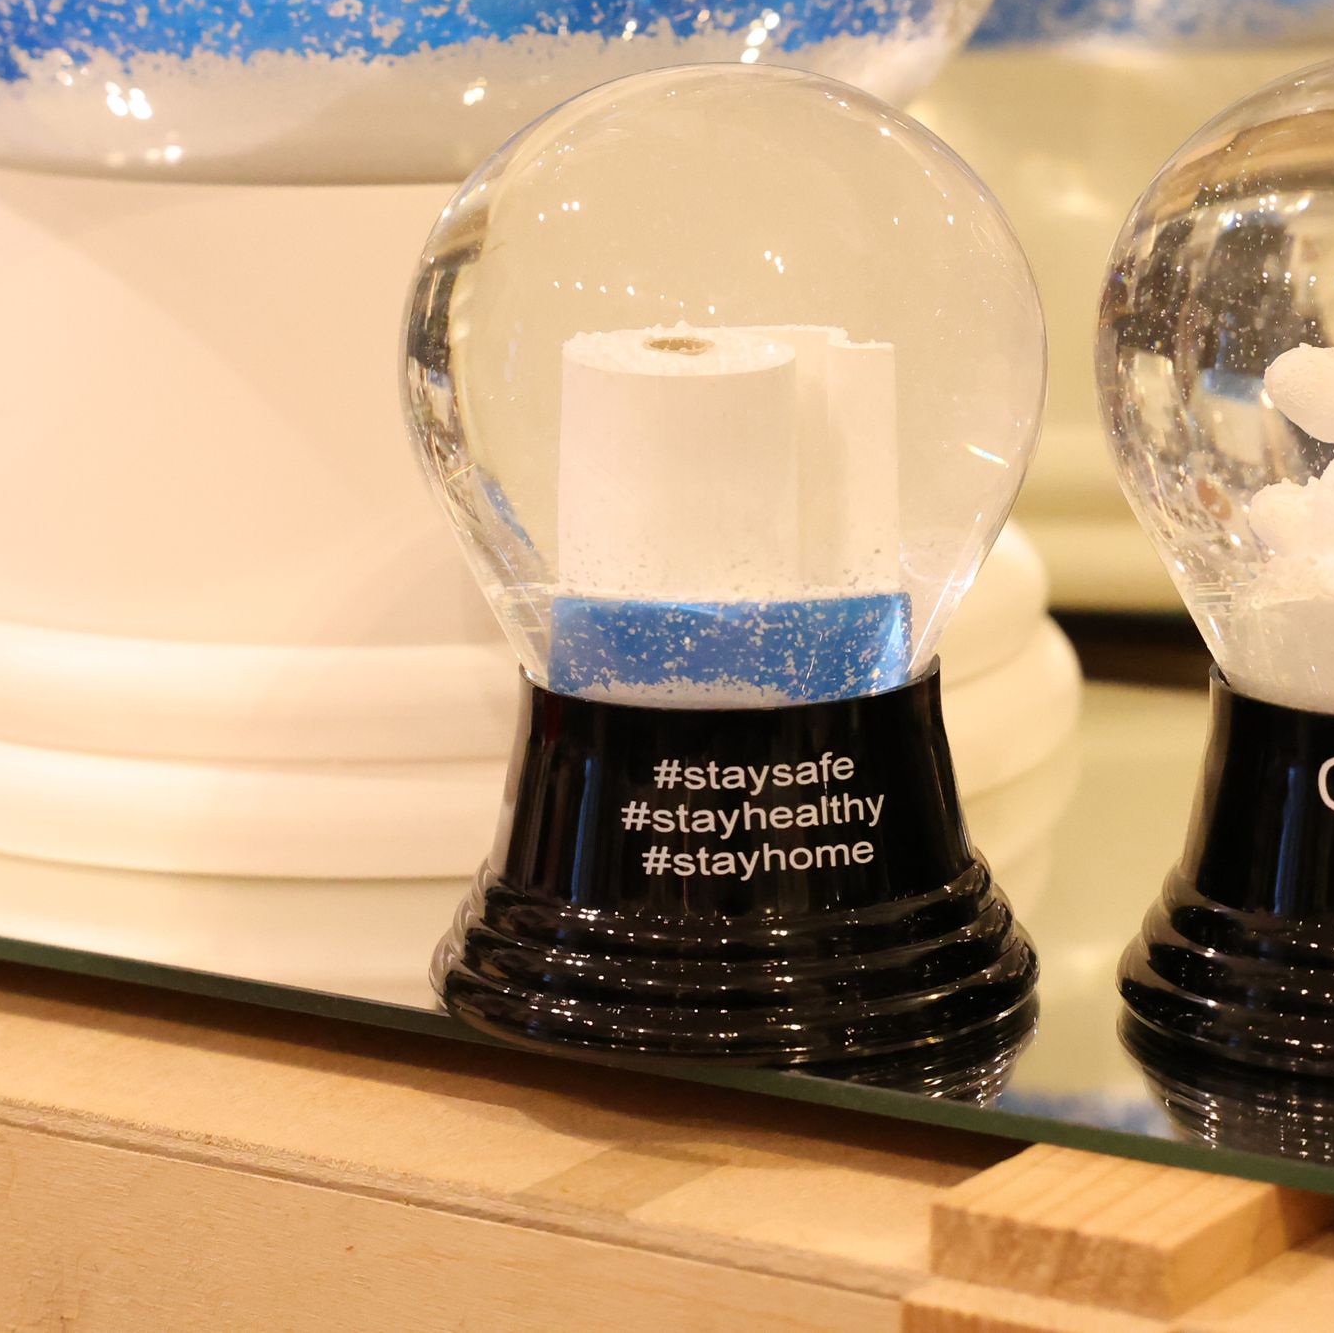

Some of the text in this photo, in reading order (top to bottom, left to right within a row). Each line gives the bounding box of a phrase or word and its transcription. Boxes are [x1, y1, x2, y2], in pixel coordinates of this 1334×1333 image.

[653, 752, 855, 796] #staysafe
[621, 793, 885, 840] #stayhealthy
[642, 840, 874, 881] #stayhome
